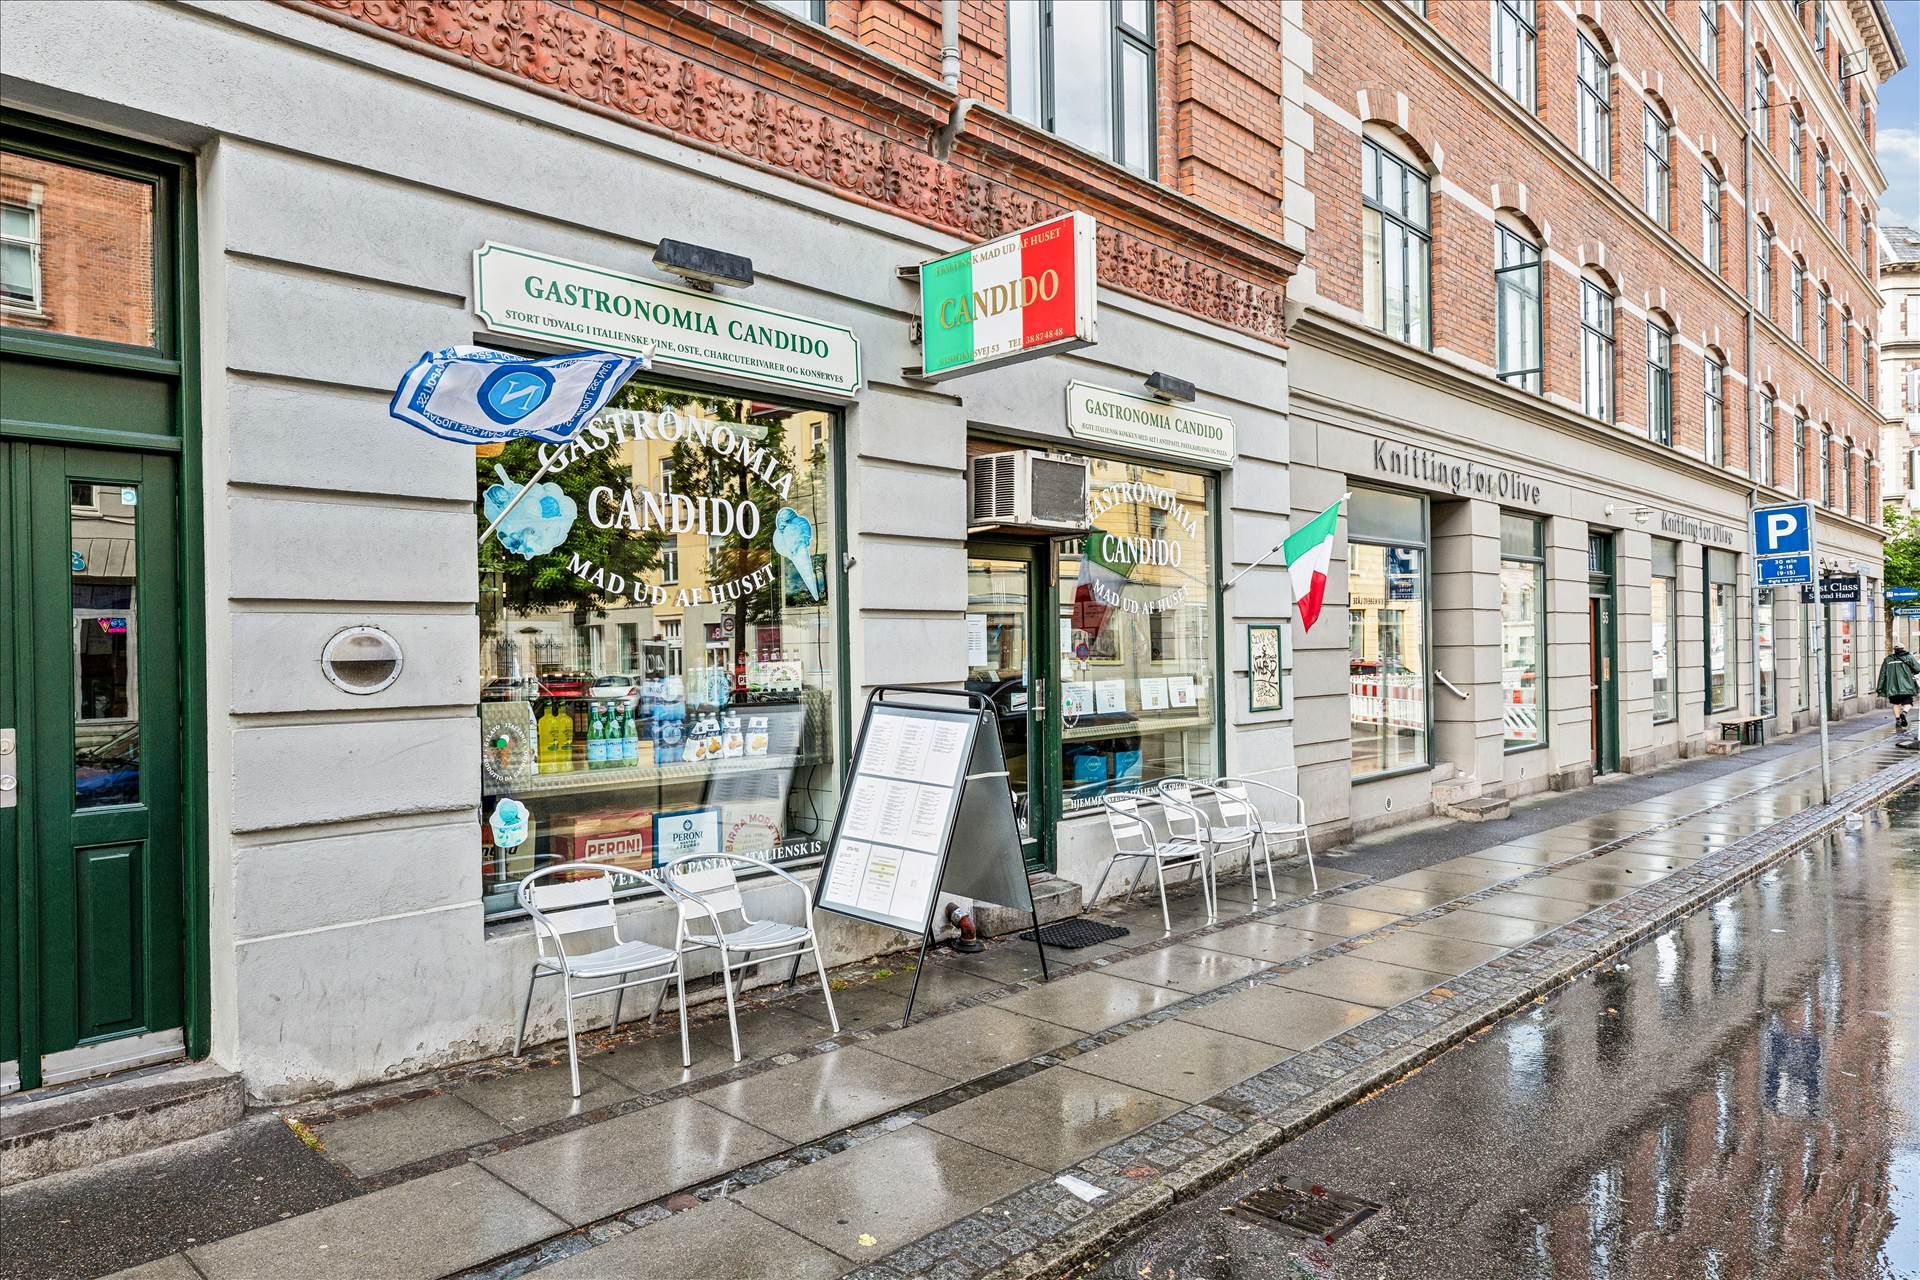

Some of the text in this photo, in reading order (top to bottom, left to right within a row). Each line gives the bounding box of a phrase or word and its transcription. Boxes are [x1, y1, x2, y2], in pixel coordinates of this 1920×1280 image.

[980, 248, 1001, 263] MAD
[1002, 242, 1016, 257] UD
[1018, 238, 1029, 250] AF
[1030, 226, 1062, 247] HUSET
[524, 275, 829, 359] GASTRONOMIA CANDIDO
[940, 268, 1060, 330] CANDIDO
[505, 309, 540, 325] STORT
[542, 316, 584, 334] UDVALG
[585, 326, 590, 334] I
[592, 327, 649, 346] ITALIENSKE
[677, 344, 703, 358] OSTE,
[704, 349, 785, 373] CHARCUTERIVARER
[786, 365, 799, 375] OG
[799, 368, 844, 384] KONSERVES
[1085, 398, 1223, 441] GASTRONOMIA CANDIDO
[538, 409, 794, 502] GASTRONOMIA
[1374, 439, 1540, 505] Knitting for Olive
[588, 485, 761, 540] CANDIDO
[1661, 511, 1698, 543] Knitting
[1713, 525, 1733, 545] Olive
[1767, 514, 1797, 550] P
[1102, 533, 1181, 568] CANDIDO
[566, 552, 778, 608] MAD UD AF HUSET
[1092, 579, 1190, 615] MAD UD AF HUSET
[1804, 582, 1858, 593] Fist Class
[1835, 591, 1855, 599] Hand
[1602, 612, 1609, 624] 55
[484, 724, 501, 747] GELATO
[588, 838, 641, 857] PERONI
[673, 831, 703, 842] PERONI
[725, 819, 748, 852] BIRRA
[748, 814, 782, 848] MORETTI
[811, 840, 822, 853] IS
